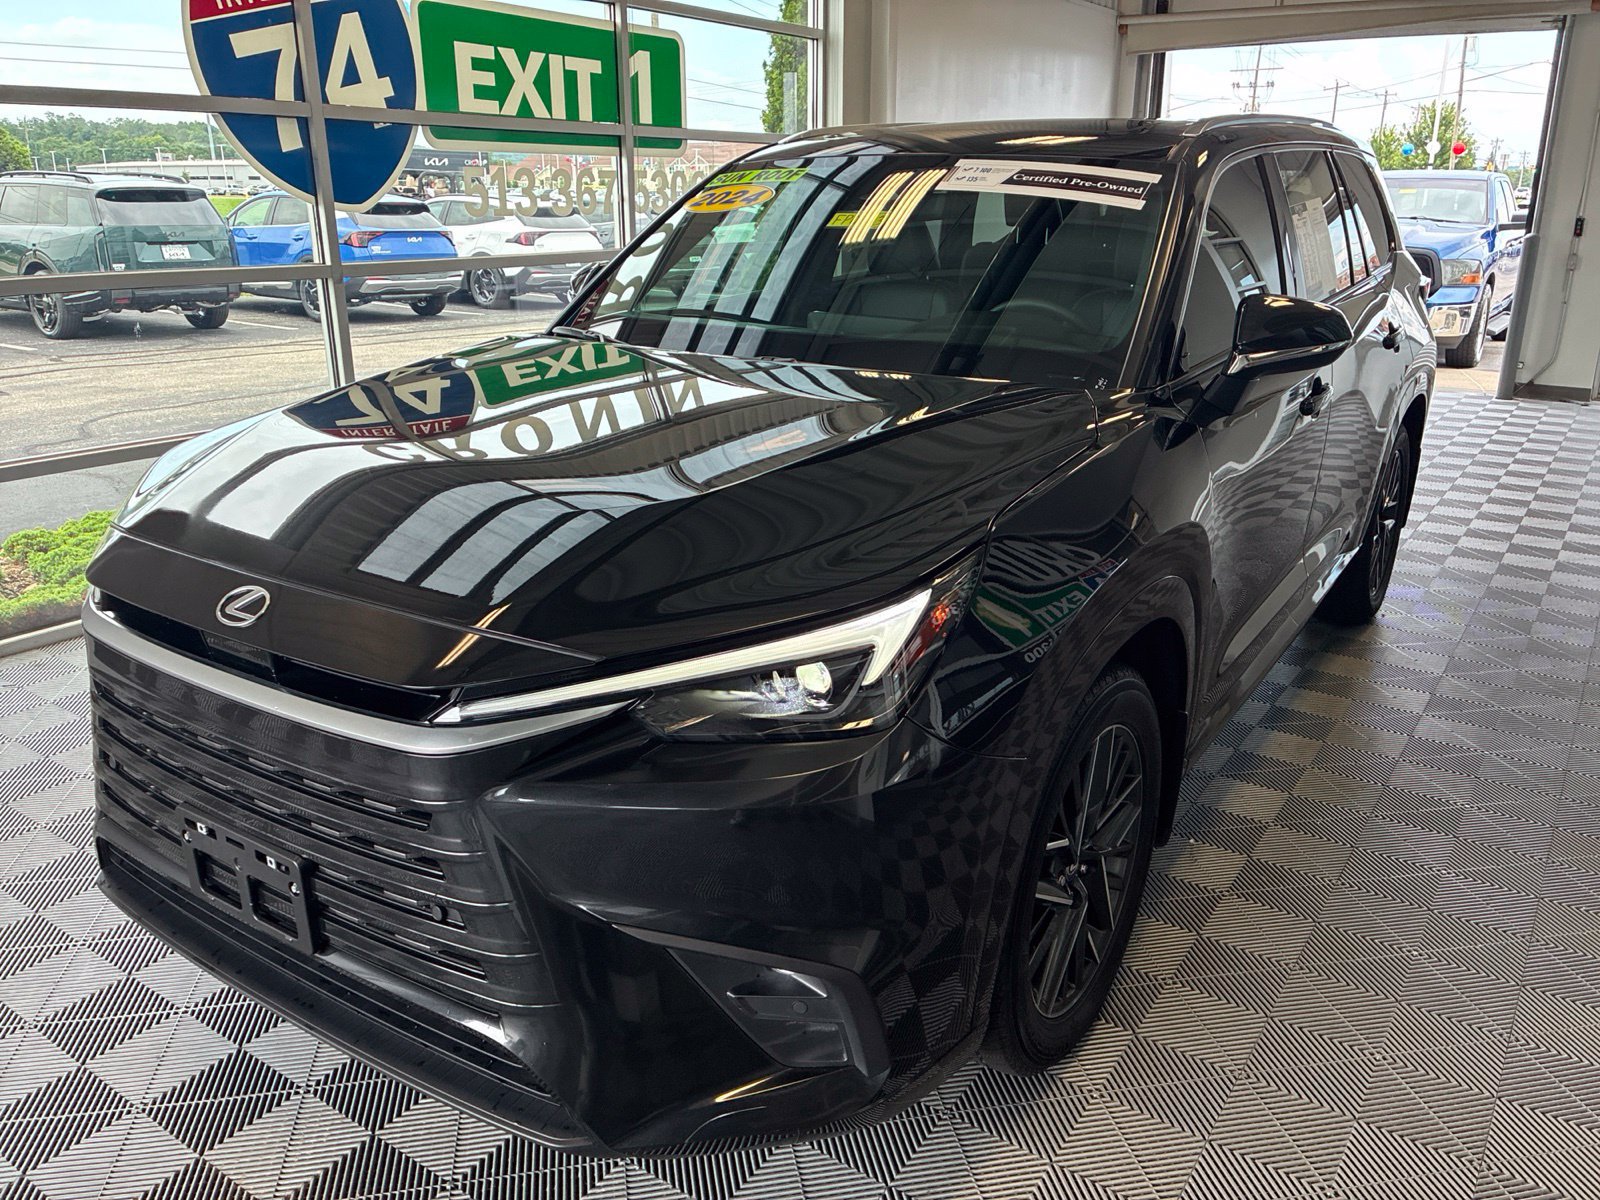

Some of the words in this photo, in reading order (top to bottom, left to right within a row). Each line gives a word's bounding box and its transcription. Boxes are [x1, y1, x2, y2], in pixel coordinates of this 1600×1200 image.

[228, 12, 395, 153] 74
[453, 41, 602, 122] EXIT
[629, 50, 653, 125] 1
[689, 189, 769, 207] 2024
[1012, 173, 1067, 185] Certified
[1069, 178, 1144, 194] Pre-Owned
